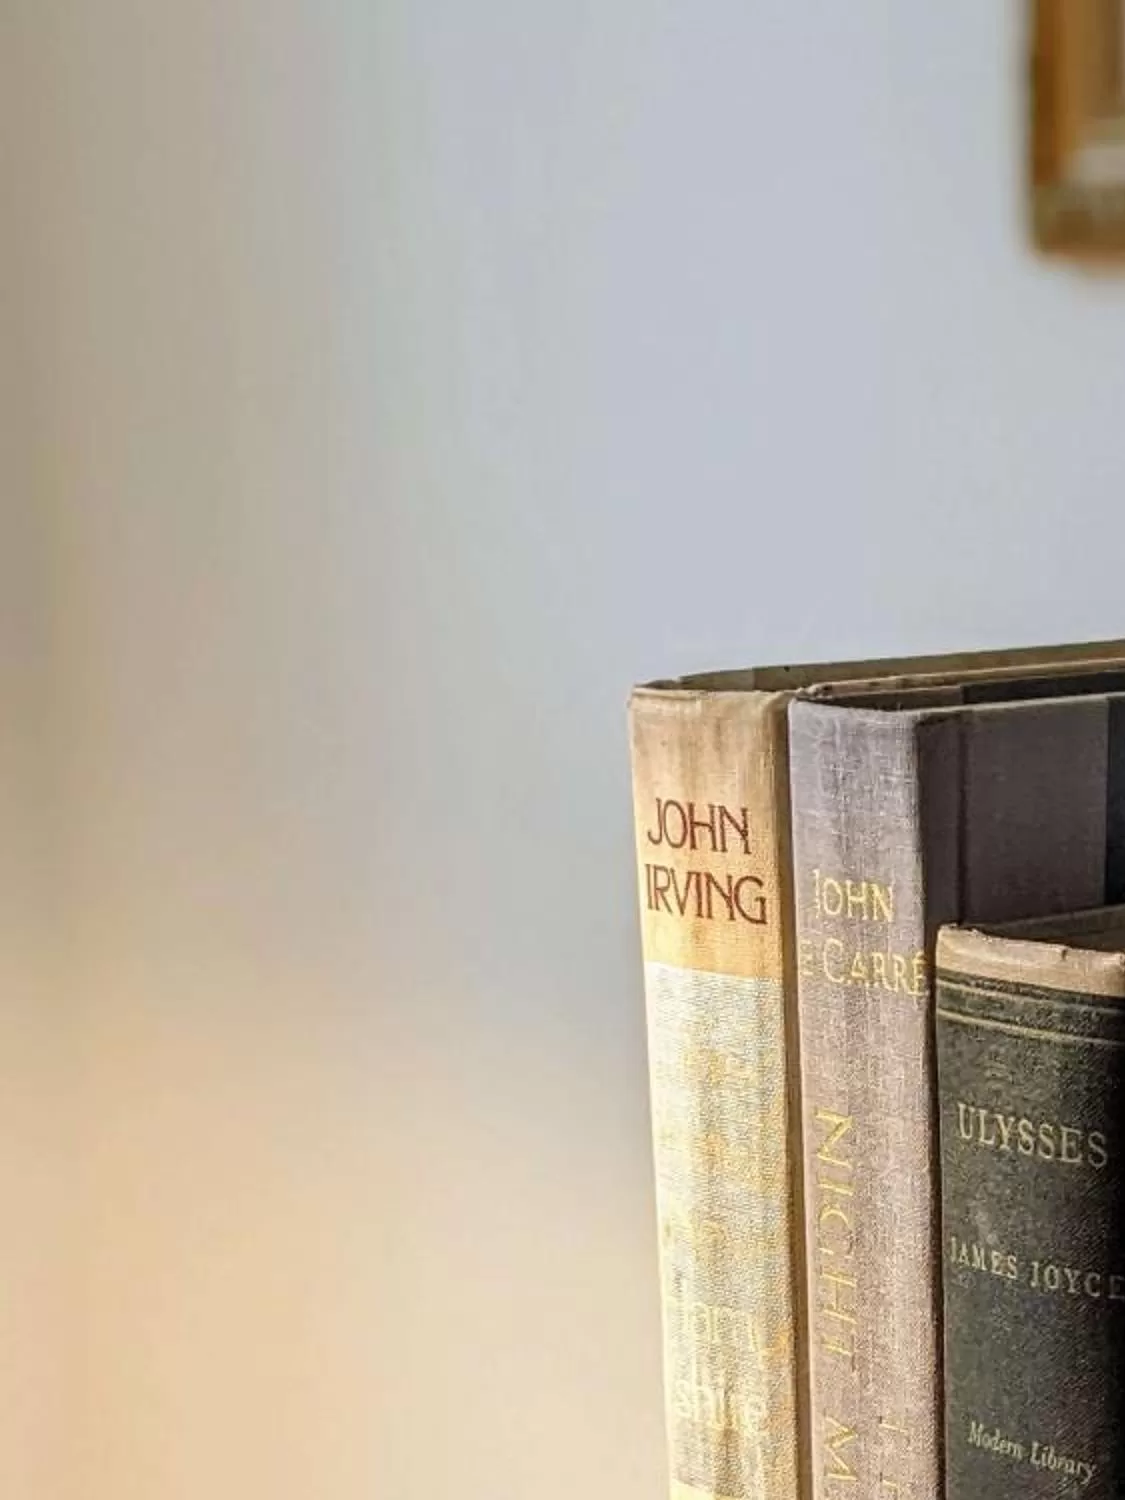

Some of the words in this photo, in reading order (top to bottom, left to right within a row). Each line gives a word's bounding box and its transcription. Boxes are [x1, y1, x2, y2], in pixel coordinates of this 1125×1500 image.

[647, 797, 753, 855] JOHN
[644, 863, 769, 925] IRVING
[812, 868, 896, 923] JOHN
[958, 1103, 1108, 1168] ULYSSES
[814, 1105, 858, 1373] NIGHT
[950, 1236, 1018, 1280] JAMES
[967, 1420, 1023, 1460] Modern
[1030, 1440, 1097, 1486] Library
